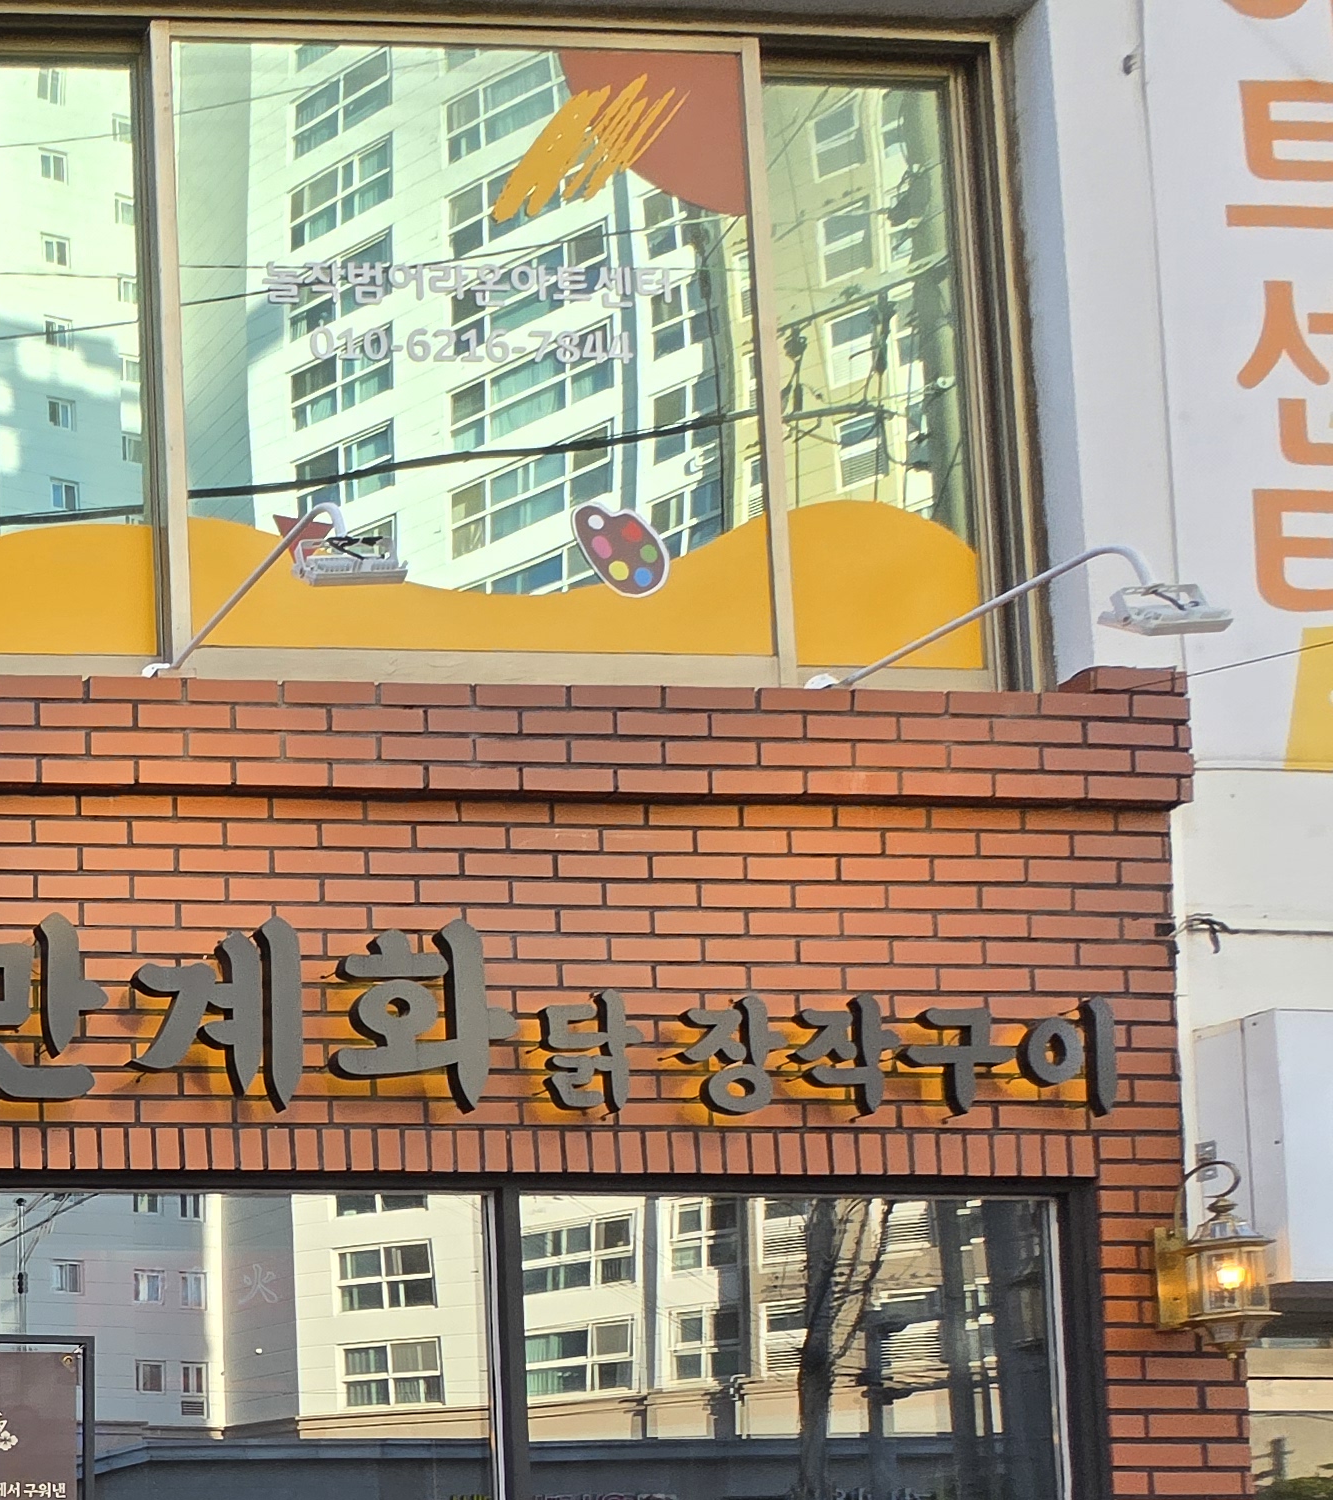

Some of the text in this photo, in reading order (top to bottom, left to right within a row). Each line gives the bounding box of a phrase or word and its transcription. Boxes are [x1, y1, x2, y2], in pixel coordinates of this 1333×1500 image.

[261, 260, 673, 308] 놀작범어라온아트센터
[309, 326, 634, 365] 010-6216-7844
[537, 989, 644, 1114] 닭
[676, 993, 1119, 1118] 장작구이
[23, 1482, 67, 1499] 구워낸
